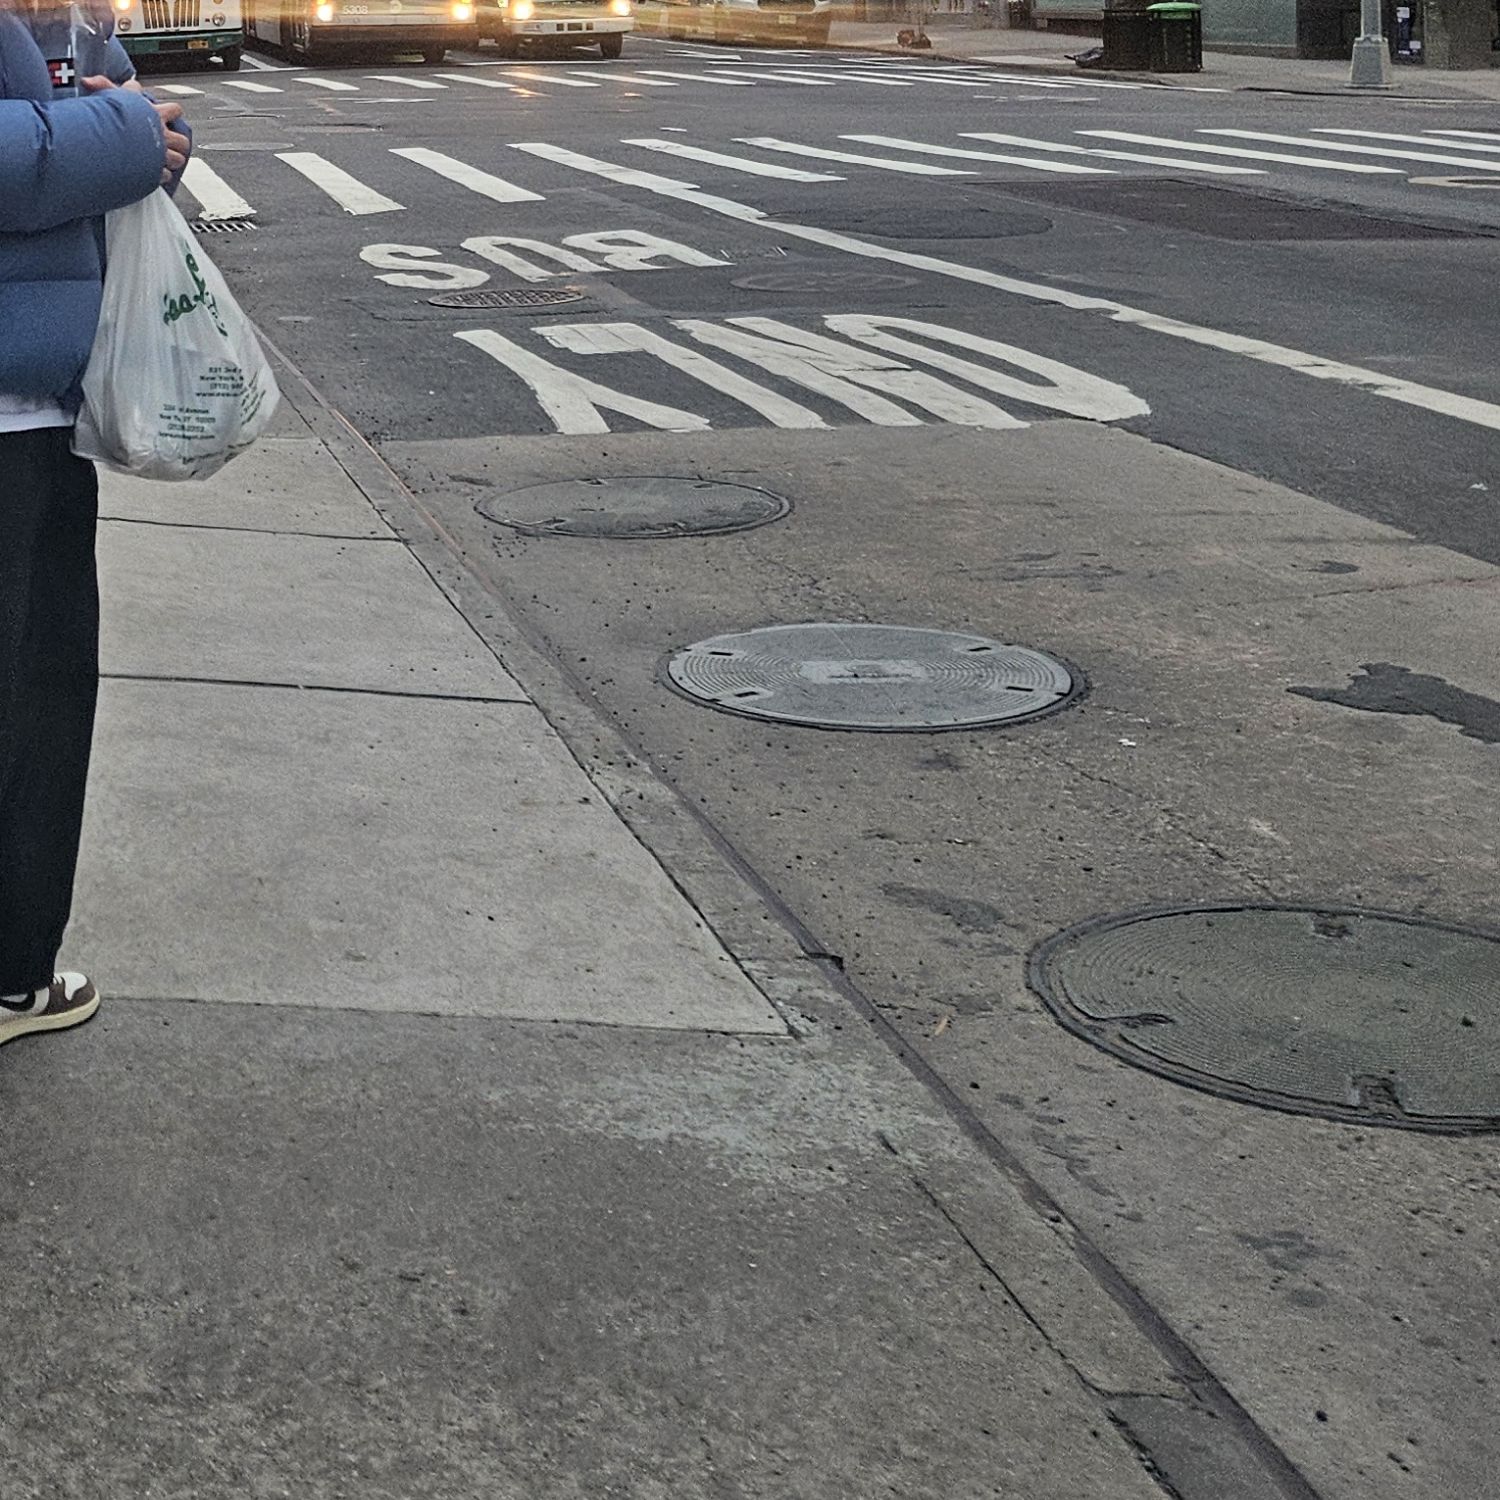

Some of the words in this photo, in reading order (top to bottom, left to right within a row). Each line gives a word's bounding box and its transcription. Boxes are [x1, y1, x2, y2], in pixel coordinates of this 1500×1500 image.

[343, 5, 368, 15] 5308
[358, 229, 735, 290] BUS
[453, 314, 1153, 435] ONLY
